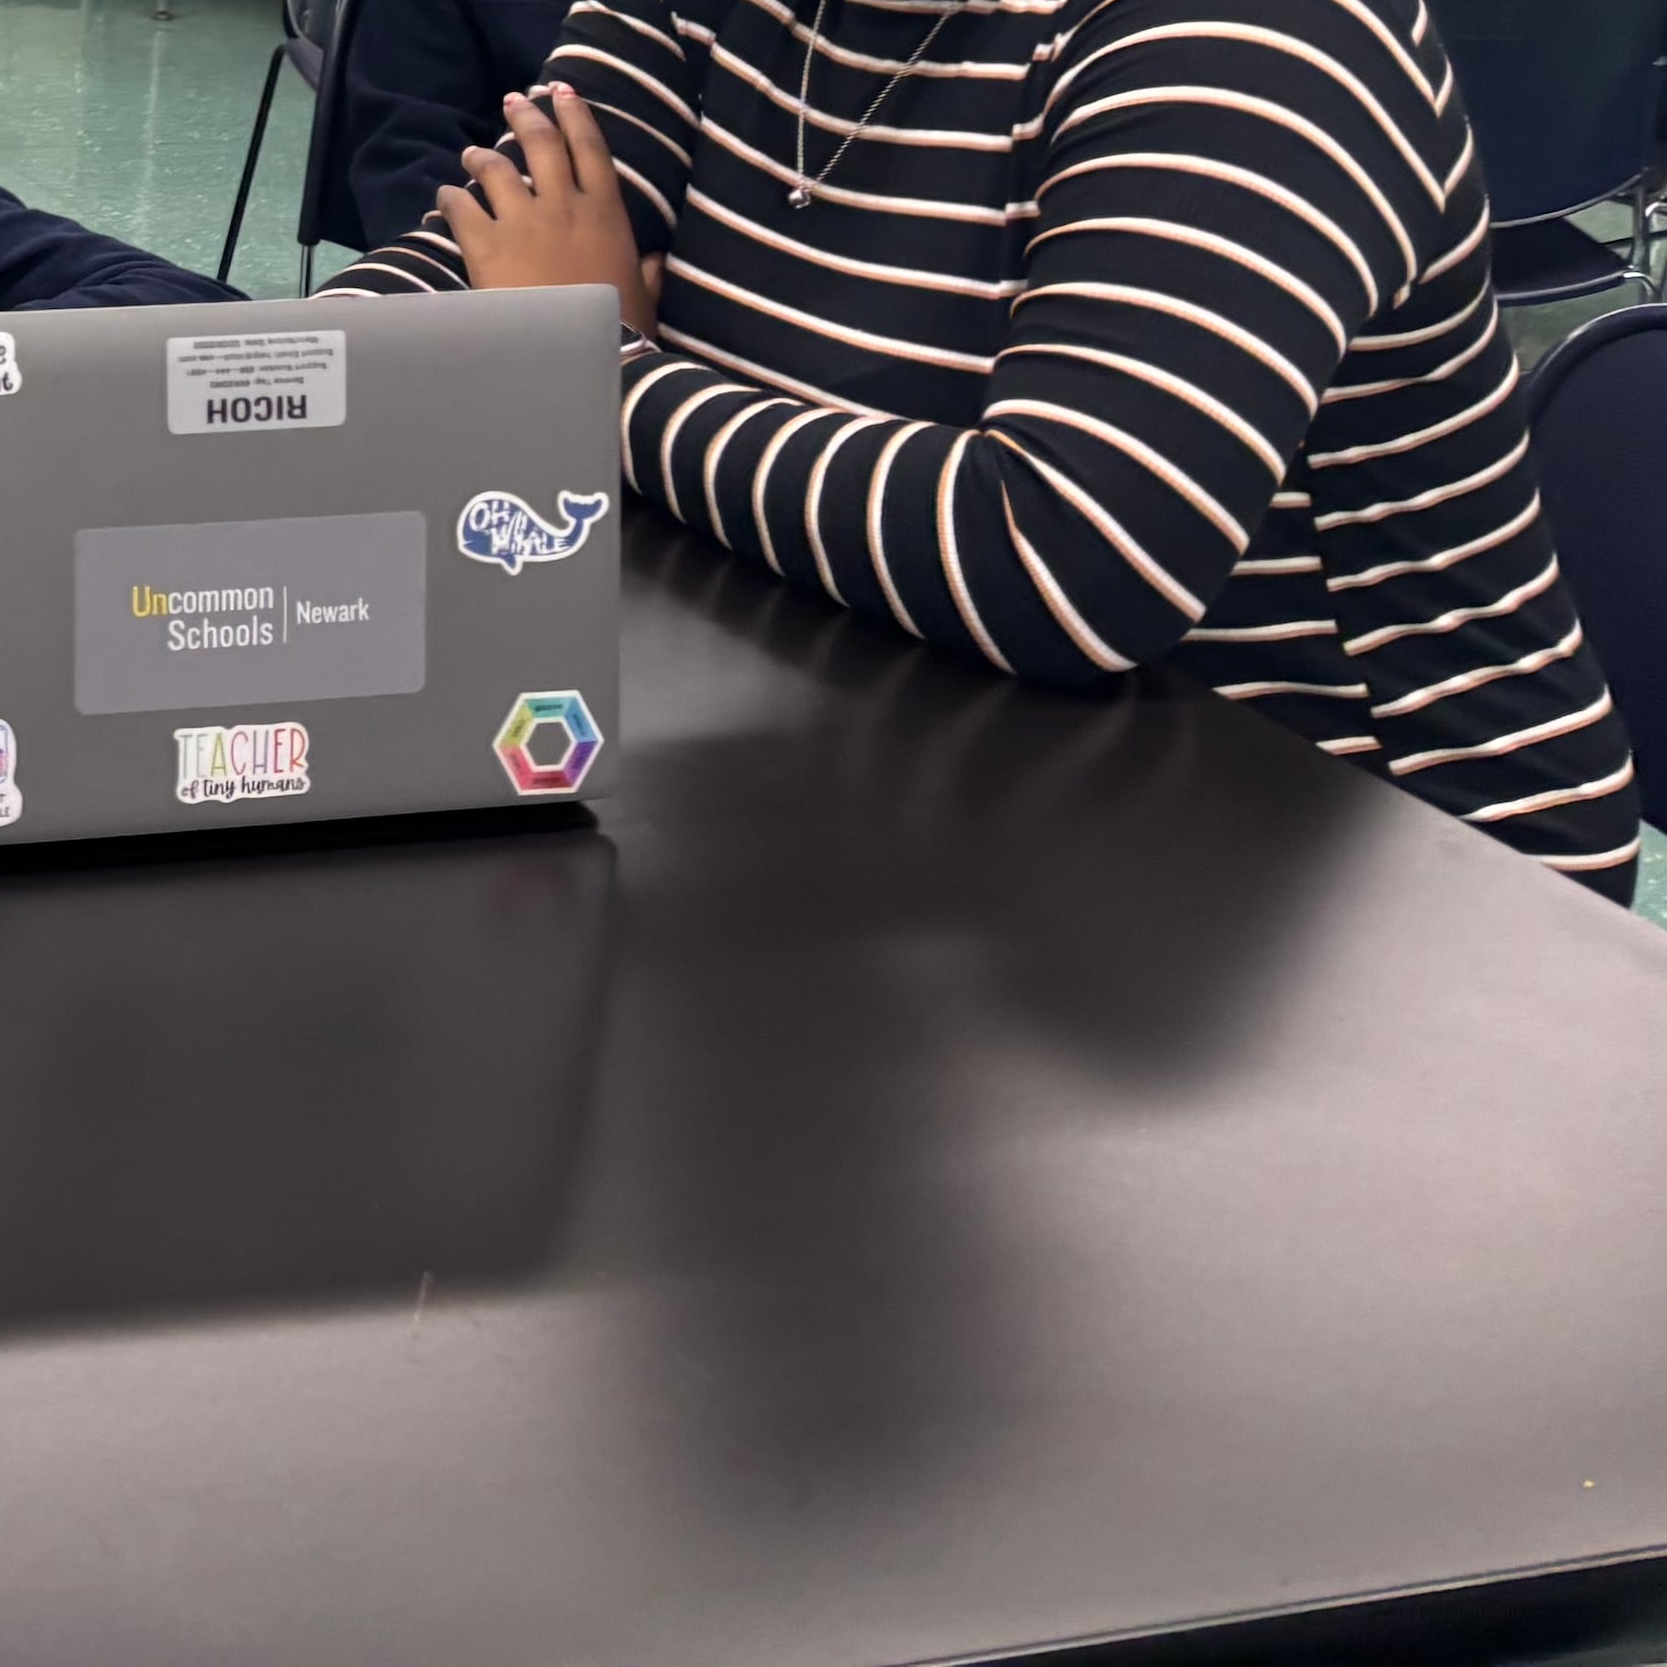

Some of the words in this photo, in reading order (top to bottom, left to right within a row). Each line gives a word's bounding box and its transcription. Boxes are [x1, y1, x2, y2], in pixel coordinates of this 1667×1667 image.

[207, 394, 307, 424] RICOH
[469, 498, 511, 532] OH
[132, 585, 274, 618] Uncommon
[296, 597, 370, 625] Newark
[168, 615, 274, 651] Schools
[178, 727, 307, 780] TEACHER
[181, 780, 199, 799] of
[203, 778, 236, 799] tiny
[241, 775, 306, 794] humans
